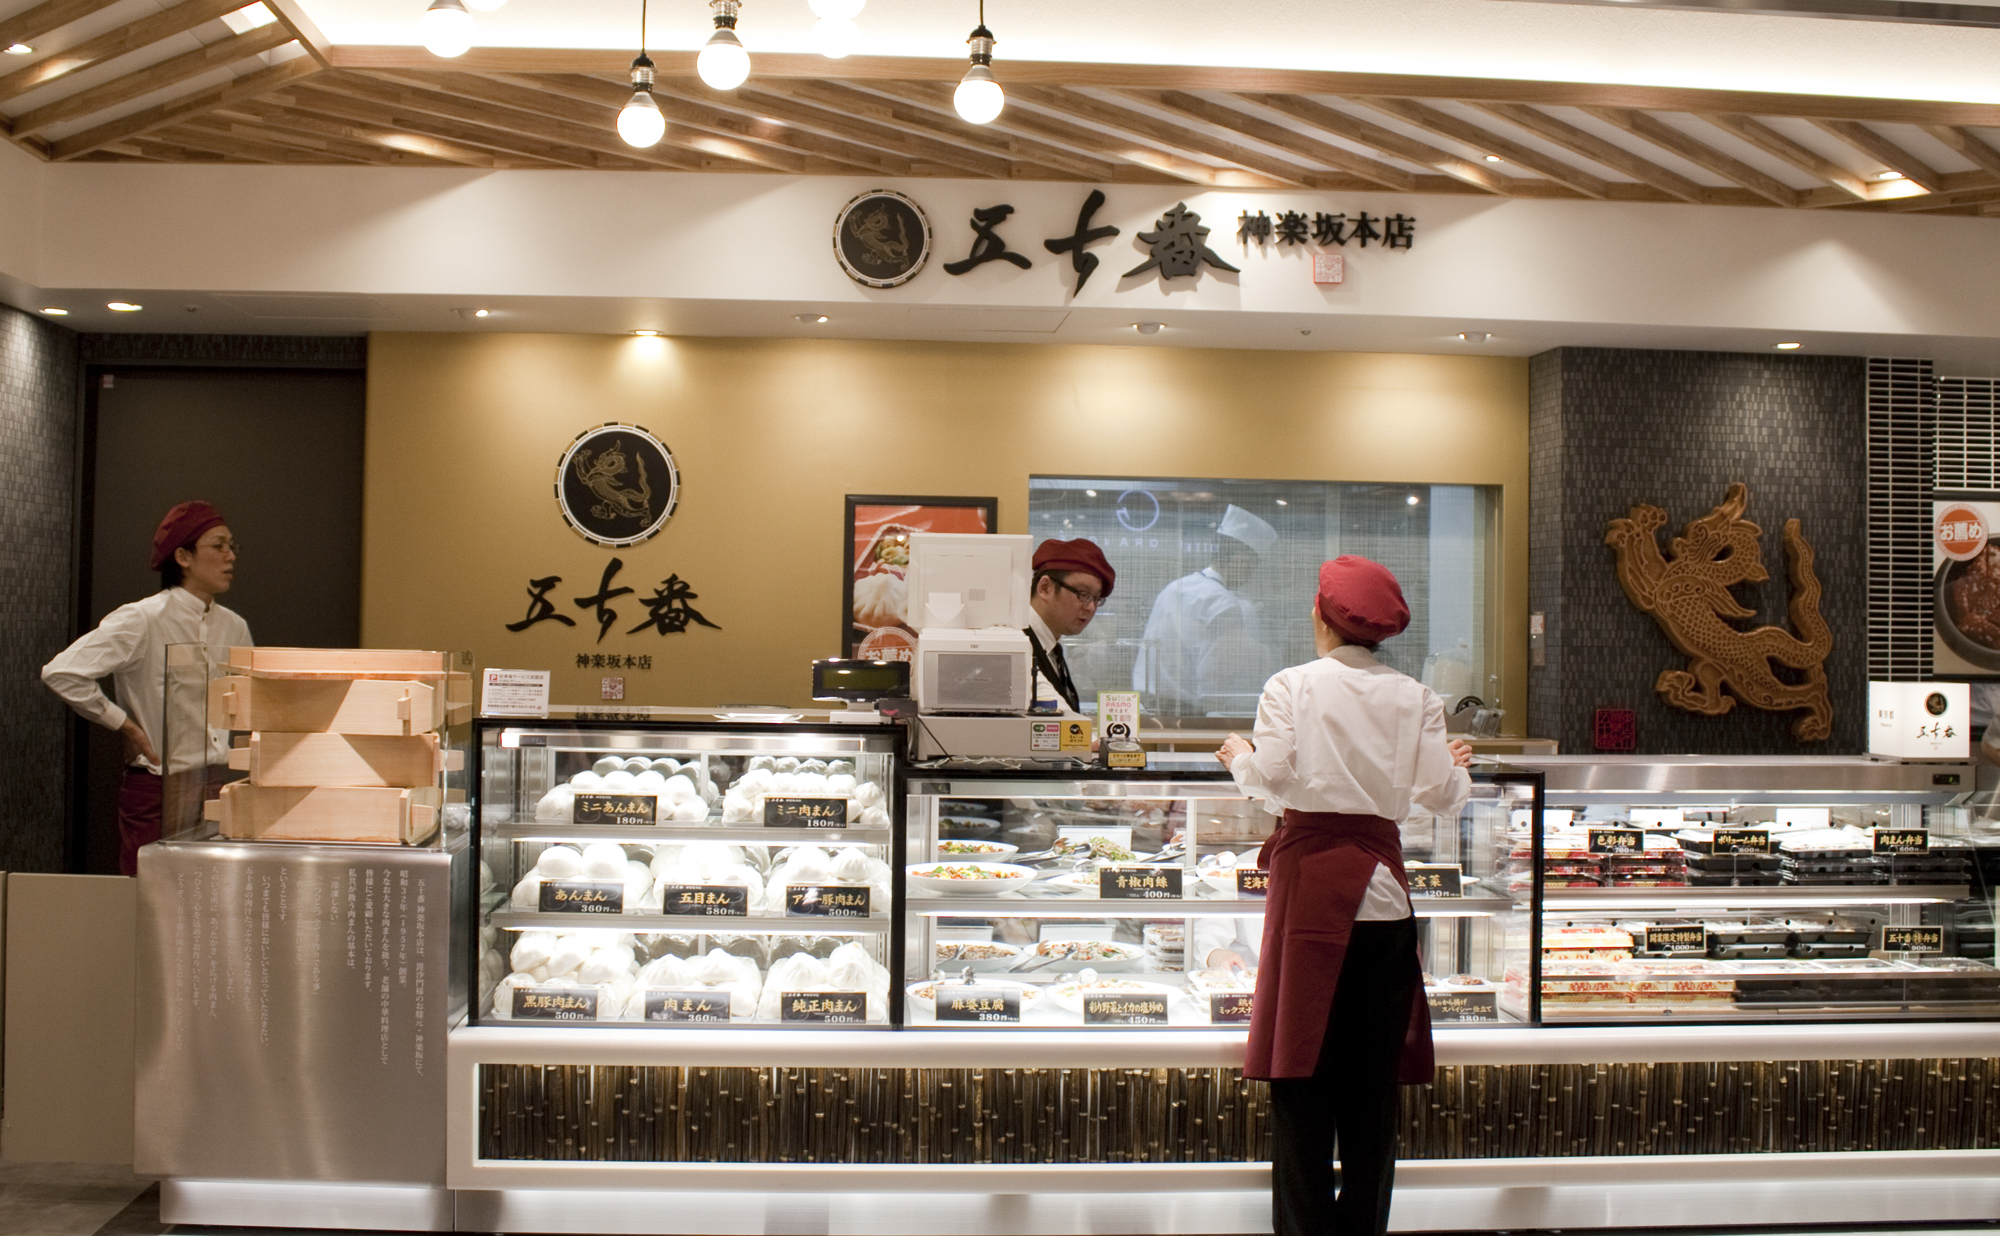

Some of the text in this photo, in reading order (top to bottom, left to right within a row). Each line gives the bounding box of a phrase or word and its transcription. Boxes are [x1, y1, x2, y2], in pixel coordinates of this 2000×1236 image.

[1238, 210, 1417, 250] 神楽坂本店
[943, 189, 1240, 298] 五十番
[1941, 522, 1982, 541] お薦め
[505, 557, 723, 644] 五十番
[575, 653, 653, 670] 神楽坂本店
[582, 801, 650, 814] ミニあんまん
[777, 804, 836, 817] ミニ肉まん
[616, 816, 644, 825] 180円
[807, 819, 834, 828] 180円
[1880, 834, 1923, 846] 肉まん弁当
[1407, 874, 1443, 888] 宝菜
[555, 888, 608, 902] あんまん
[678, 892, 731, 905] 五目まん
[581, 904, 610, 913] 360円
[705, 907, 735, 916] 580円
[828, 908, 857, 917] 500円
[523, 995, 588, 1009] 黒豚肉まん
[663, 998, 712, 1012] 肉まん
[792, 998, 858, 1013] 純正肉まん
[951, 998, 1005, 1011] 麻婆豆腐
[554, 1011, 584, 1020] 500円
[687, 1013, 717, 1023] 360円
[824, 1015, 854, 1024] 500円
[978, 1013, 1008, 1022] 380円
